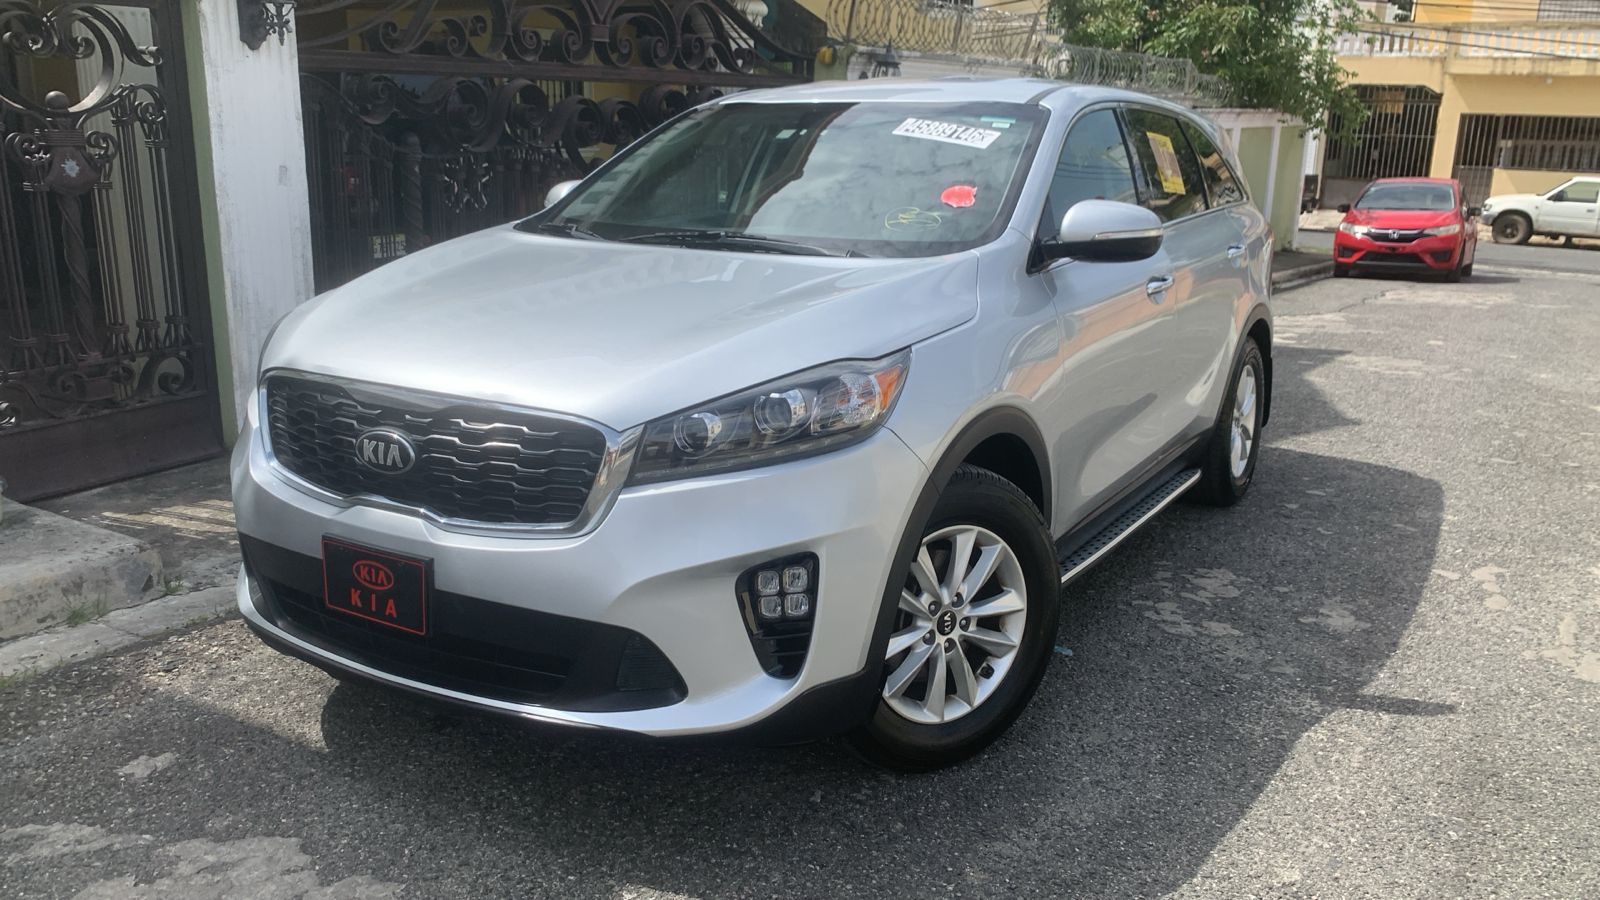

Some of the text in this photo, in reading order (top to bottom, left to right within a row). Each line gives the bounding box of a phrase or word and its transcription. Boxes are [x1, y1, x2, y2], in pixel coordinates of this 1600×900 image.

[363, 439, 404, 468] KIA
[359, 565, 388, 586] KIA
[351, 588, 397, 618] KIA
[943, 612, 952, 634] KIA
